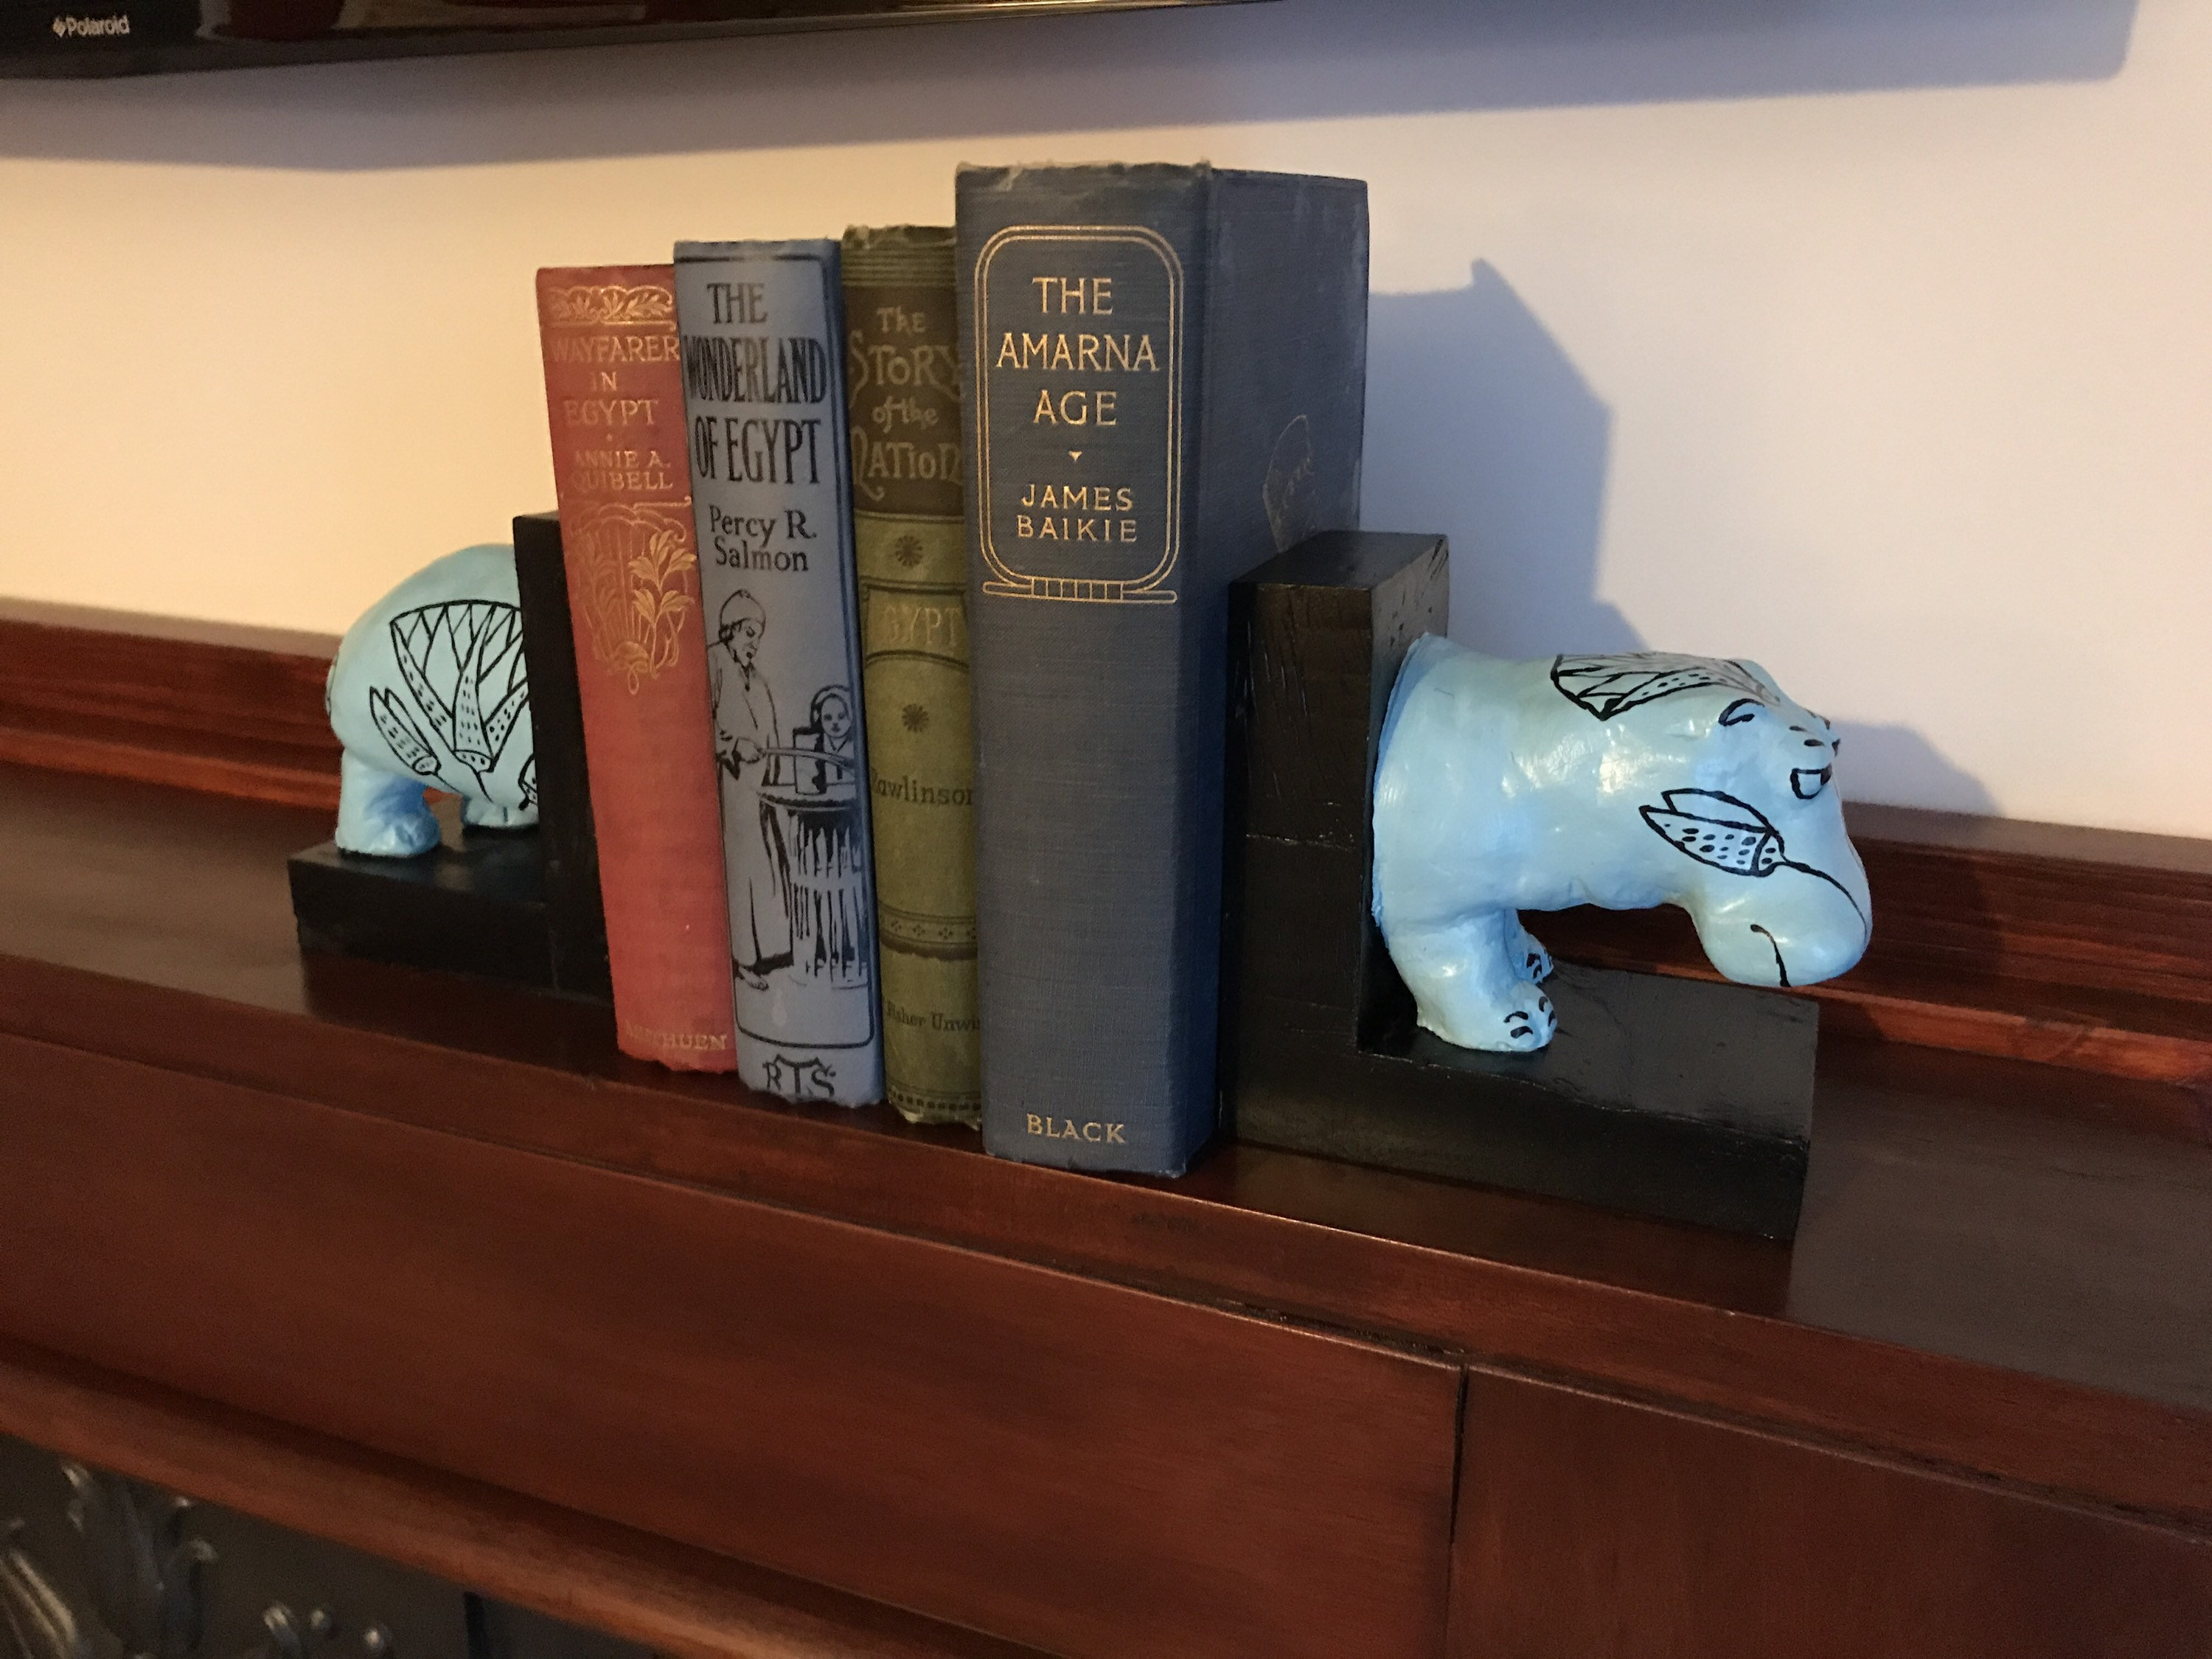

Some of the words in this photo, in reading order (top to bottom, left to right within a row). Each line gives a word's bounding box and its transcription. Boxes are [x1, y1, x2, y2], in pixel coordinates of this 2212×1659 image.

[66, 13, 130, 36] Polaroid
[707, 282, 768, 324] THE
[1032, 276, 1113, 315] THE
[549, 334, 680, 363] WAYFARER
[996, 332, 1160, 372] AMARNA
[591, 371, 618, 392] IN
[684, 335, 827, 404] WONDERLAND
[563, 398, 660, 426] EGYPT
[1033, 389, 1118, 426] AGE
[695, 415, 718, 481] OF
[725, 417, 821, 484] EGYPT
[1020, 484, 1134, 512] JAMES
[709, 504, 776, 547] Percy
[784, 508, 817, 540] R.
[1016, 514, 1138, 543] BAIKIE
[714, 535, 810, 572] Salmon
[877, 604, 961, 647] GYPT
[1026, 1113, 1127, 1144] BLACK
